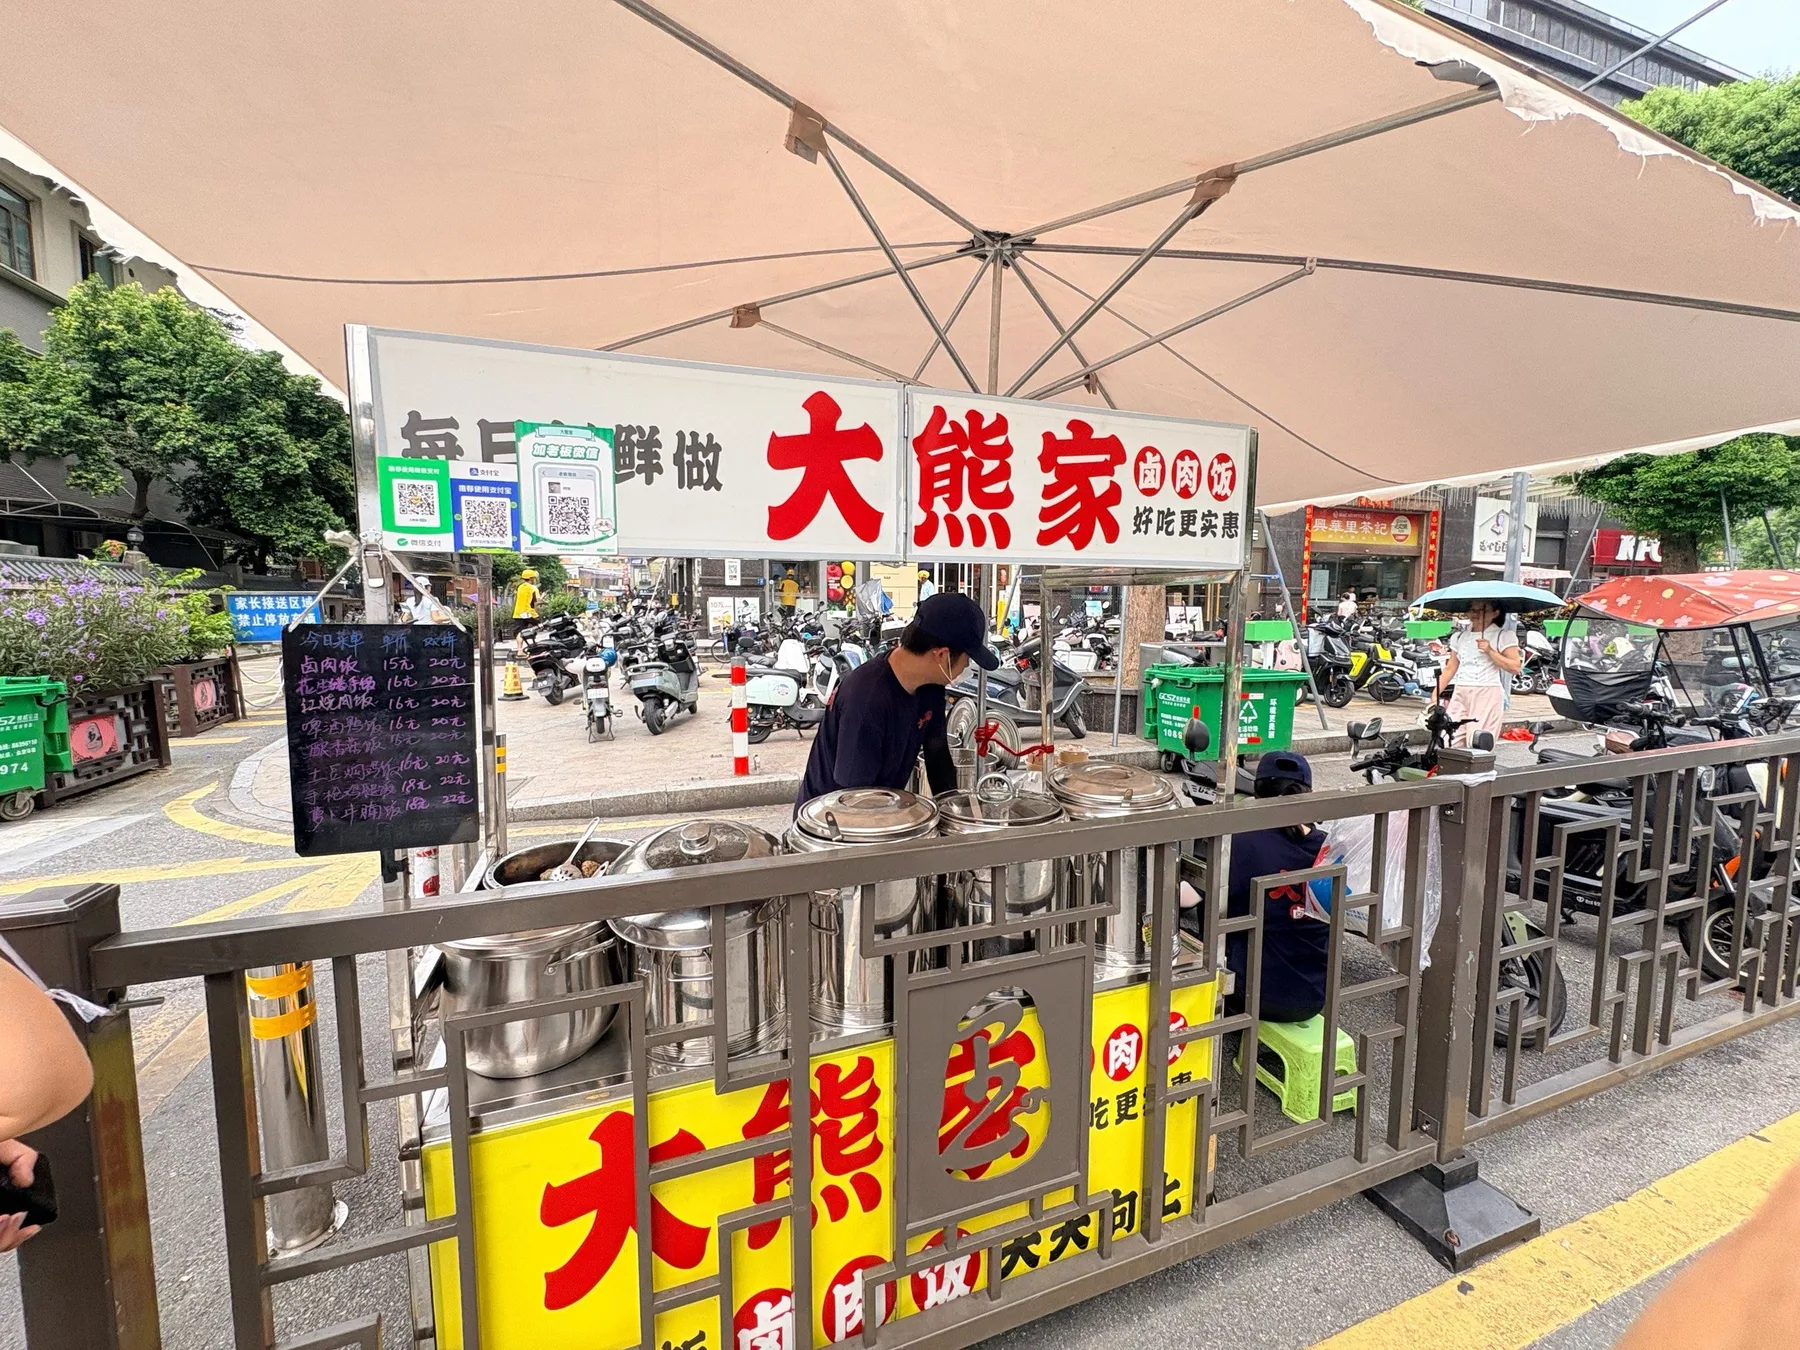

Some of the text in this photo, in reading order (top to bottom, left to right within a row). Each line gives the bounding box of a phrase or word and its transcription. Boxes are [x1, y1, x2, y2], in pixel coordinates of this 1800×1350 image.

[400, 410, 724, 492] 每日鲜做
[532, 442, 600, 461] 加老板微信
[480, 469, 499, 477] 支付宝
[767, 390, 1127, 551] 大熊家
[1137, 448, 1234, 499] 卤肉饭
[458, 484, 512, 495] 推荐使用支付宝
[1132, 505, 1240, 540] 好吃更实惠
[1312, 518, 1389, 536] 興華里茶記
[410, 539, 441, 547] 微信支付
[234, 596, 315, 611] 家长接送区域
[300, 630, 364, 656] 今日菜单
[300, 655, 467, 674] 卤肉饭 15元 20元
[388, 675, 418, 690] 16元
[431, 675, 467, 686] 20元
[389, 698, 420, 710] 16元
[431, 696, 467, 709] 20元
[389, 716, 421, 731] 16元
[431, 715, 467, 727] 20元
[400, 752, 429, 771] 16元
[435, 752, 470, 766] 20元
[402, 779, 432, 794] 18元
[440, 772, 471, 786] 22元
